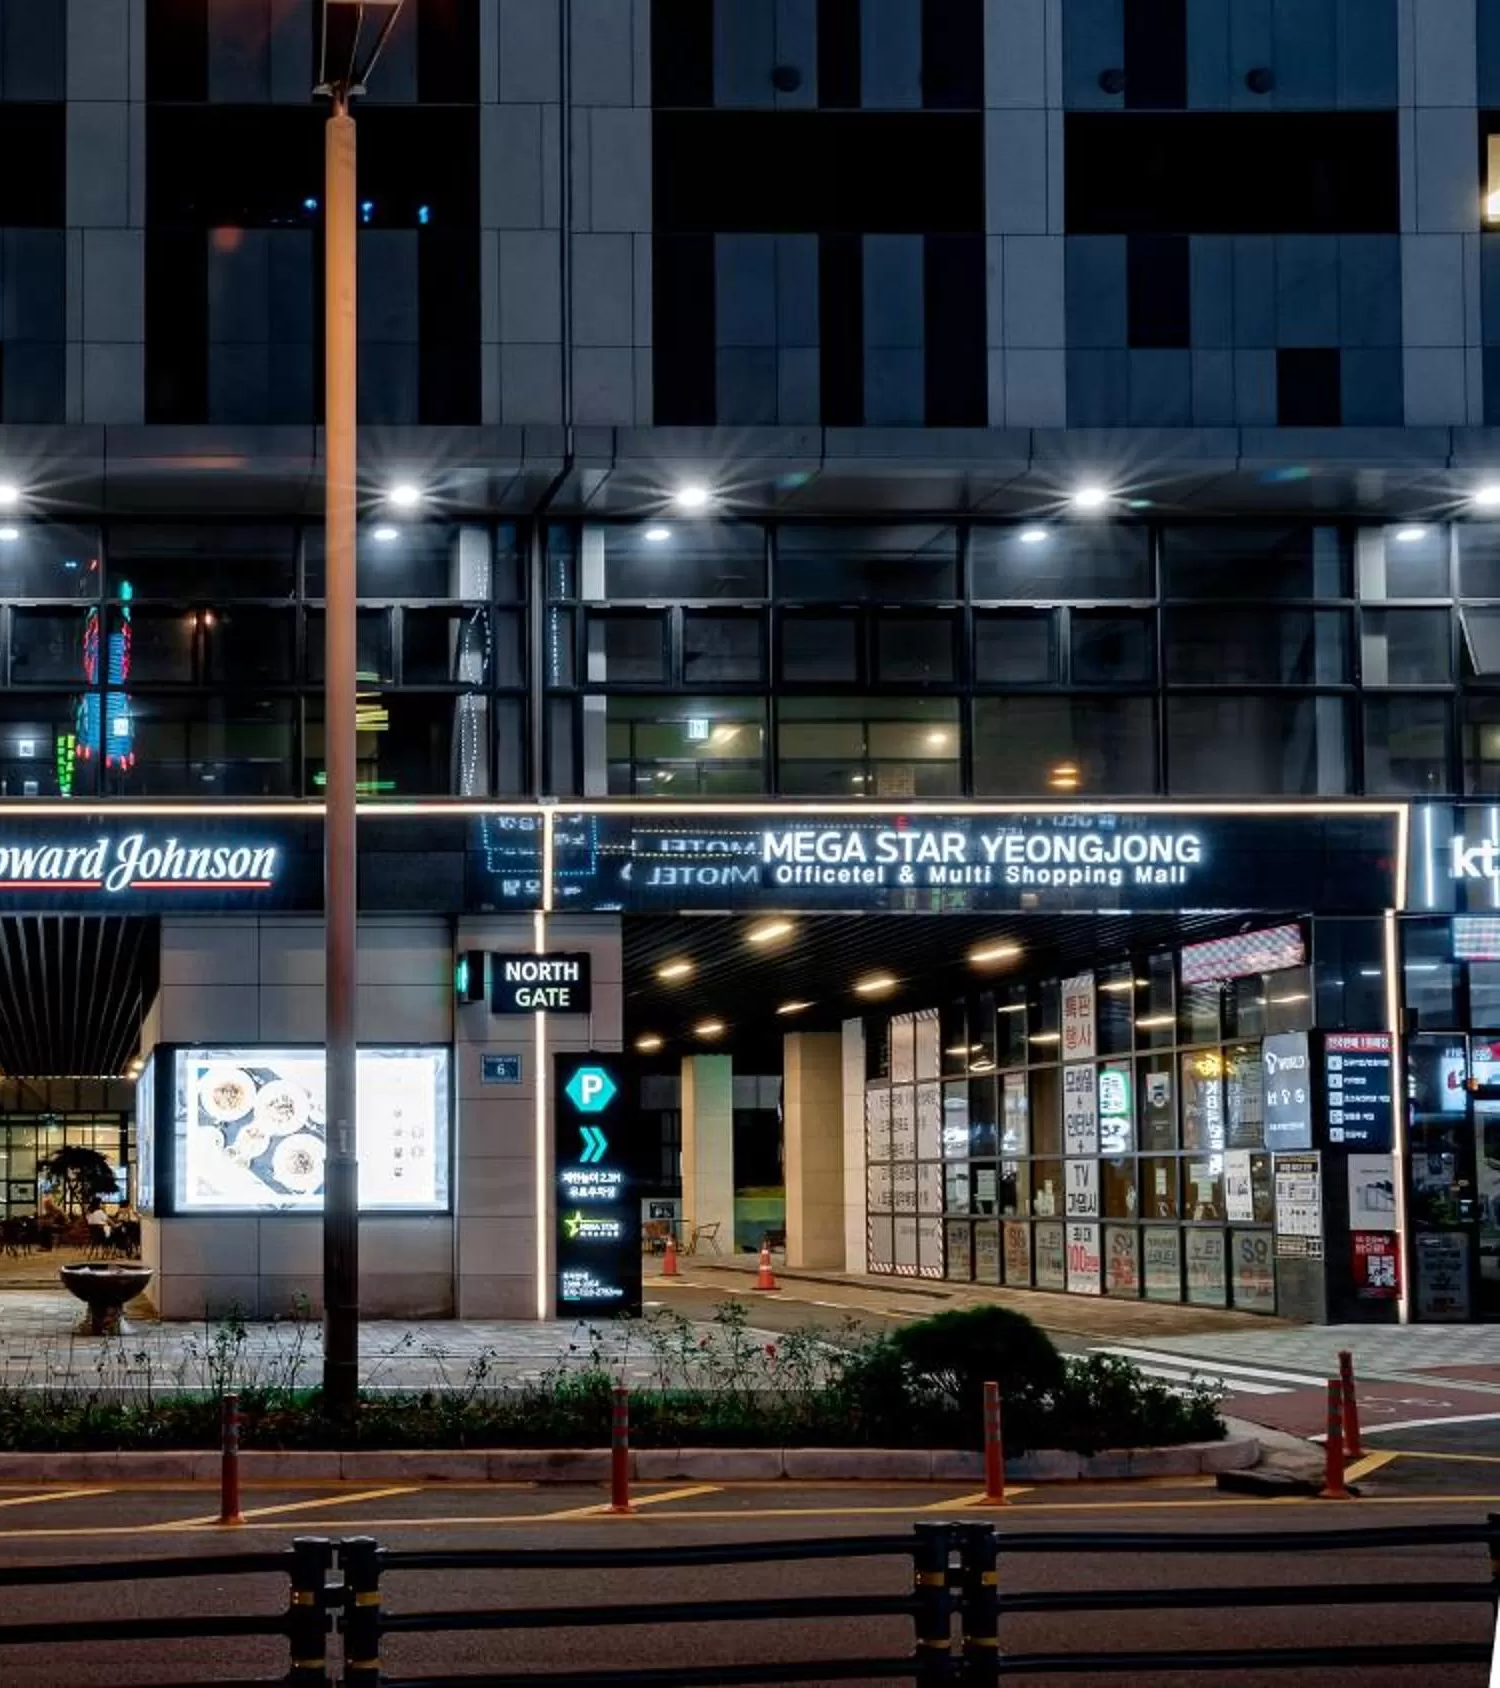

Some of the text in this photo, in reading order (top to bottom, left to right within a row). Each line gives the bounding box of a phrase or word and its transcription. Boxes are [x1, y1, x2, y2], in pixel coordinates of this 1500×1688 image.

[762, 831, 1202, 864] MEGA STAR YEONGJONG
[106, 833, 276, 892] Johnson
[776, 864, 1187, 886] Officetel & Multi Shopping Mall
[505, 962, 579, 982] NORTH
[515, 988, 571, 1007] GATE
[497, 1063, 505, 1076] 6
[580, 1074, 604, 1105] P
[1074, 1165, 1090, 1187] TV
